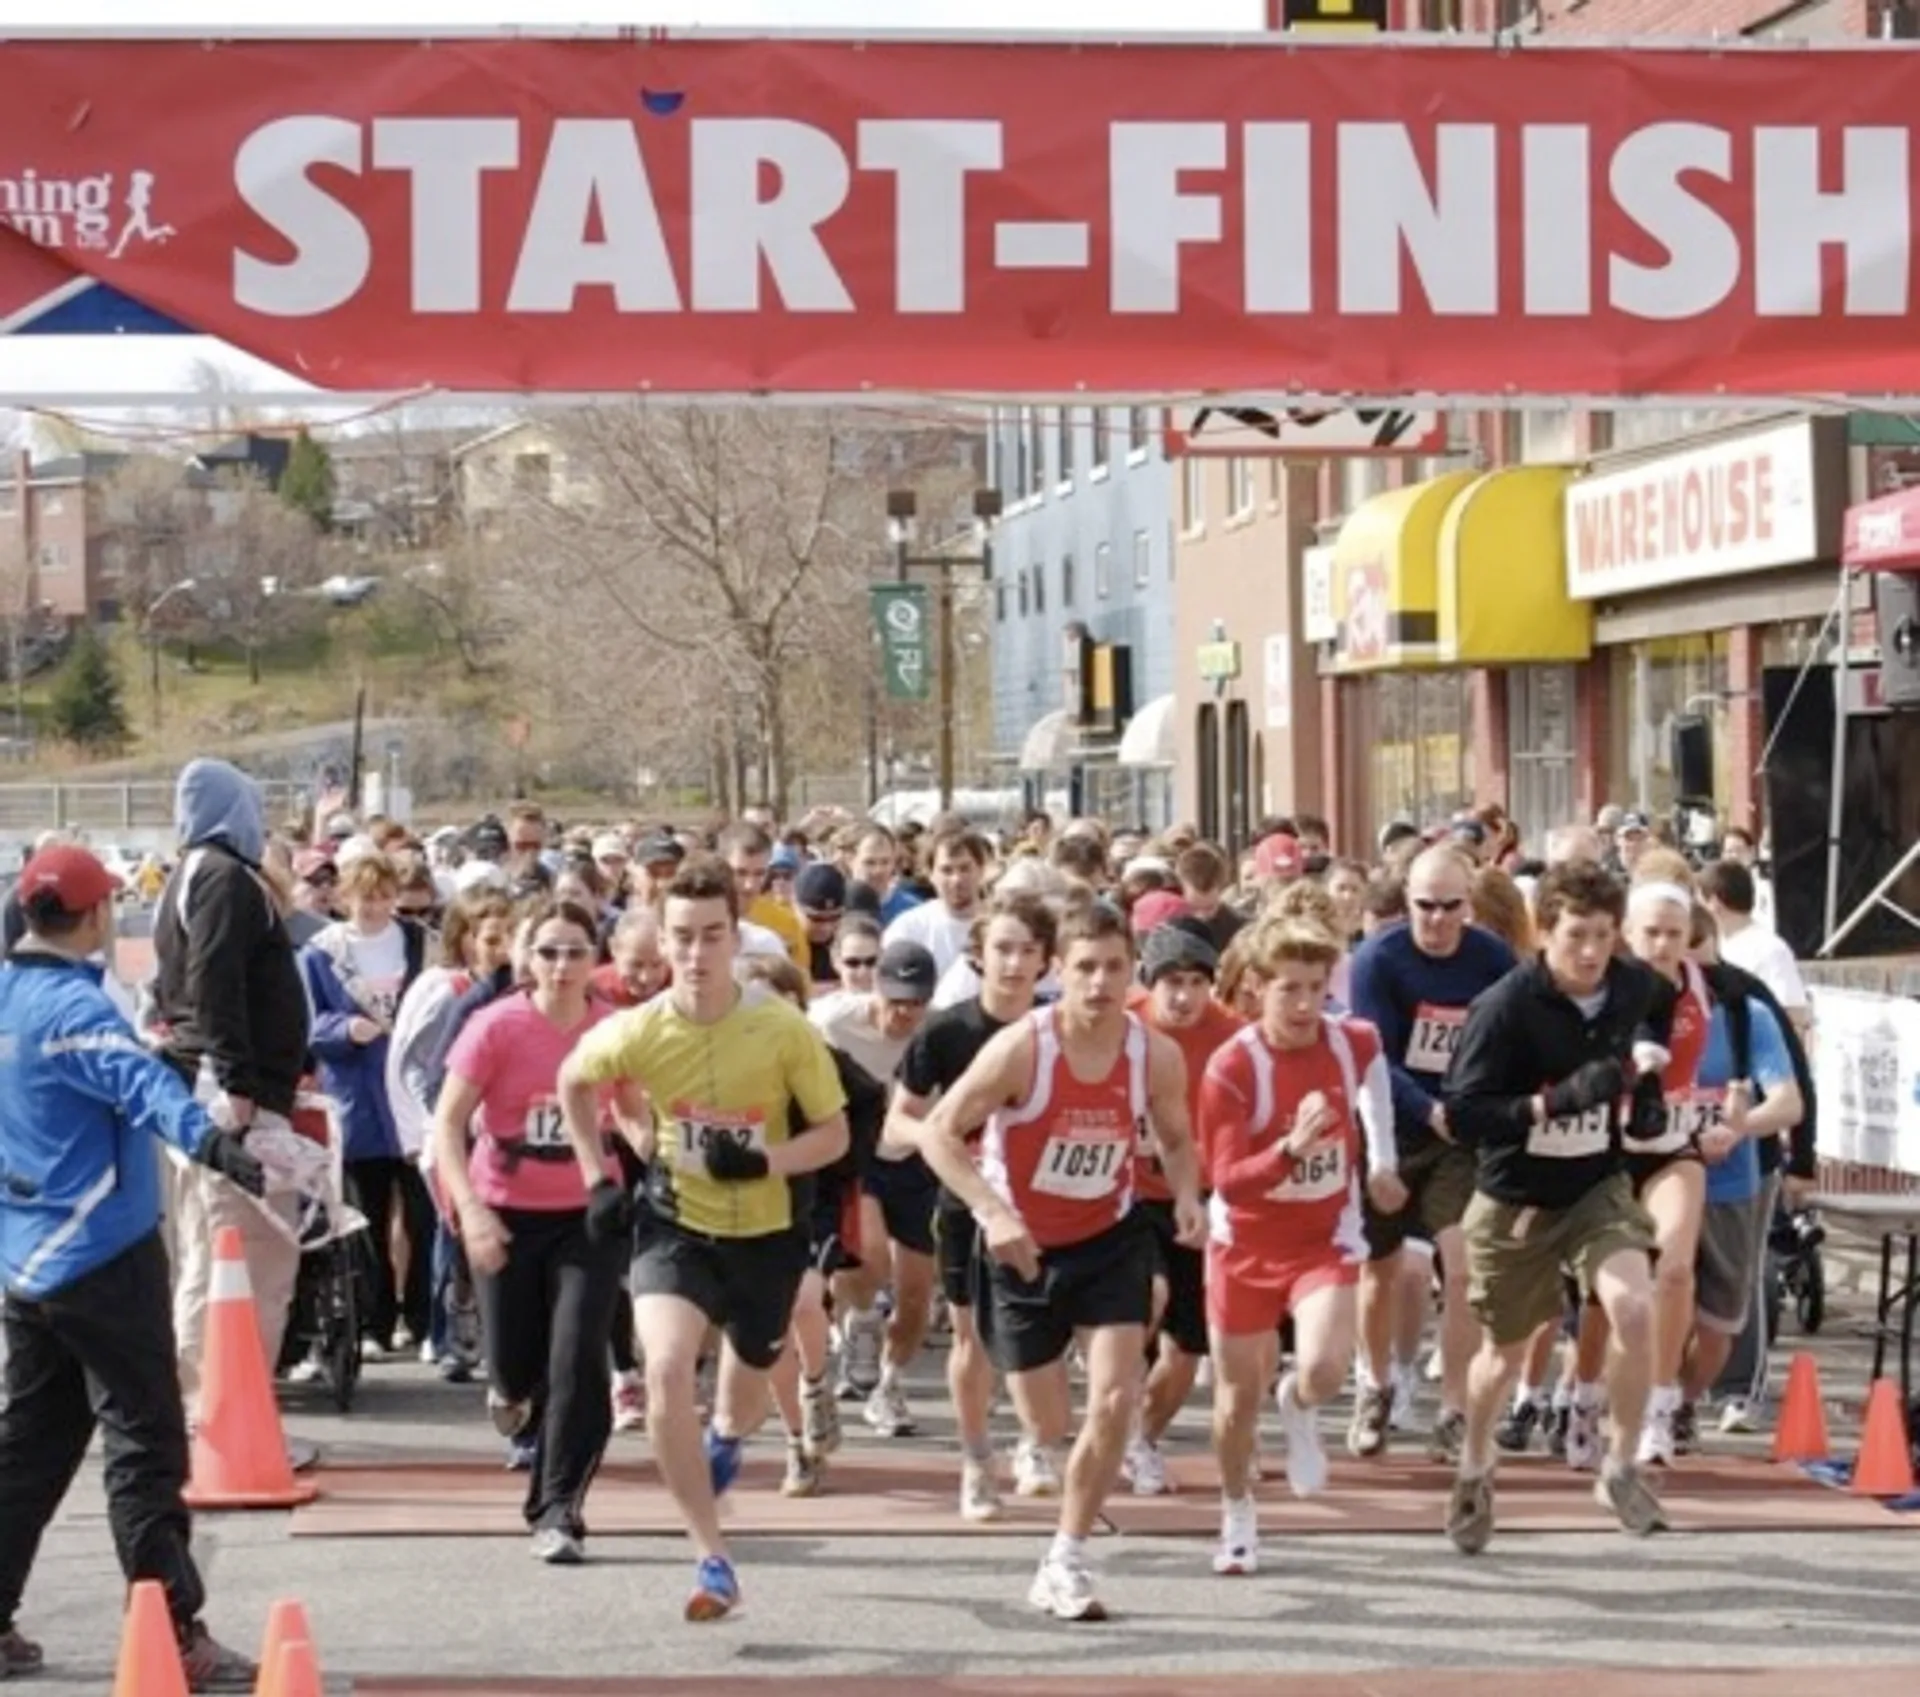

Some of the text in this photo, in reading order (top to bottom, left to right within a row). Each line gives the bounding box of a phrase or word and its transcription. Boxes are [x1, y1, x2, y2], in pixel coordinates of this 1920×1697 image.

[234, 115, 1908, 319] START-FINISH
[1575, 453, 1773, 574] WAREHOUSE
[1050, 1142, 1116, 1177] 1051
